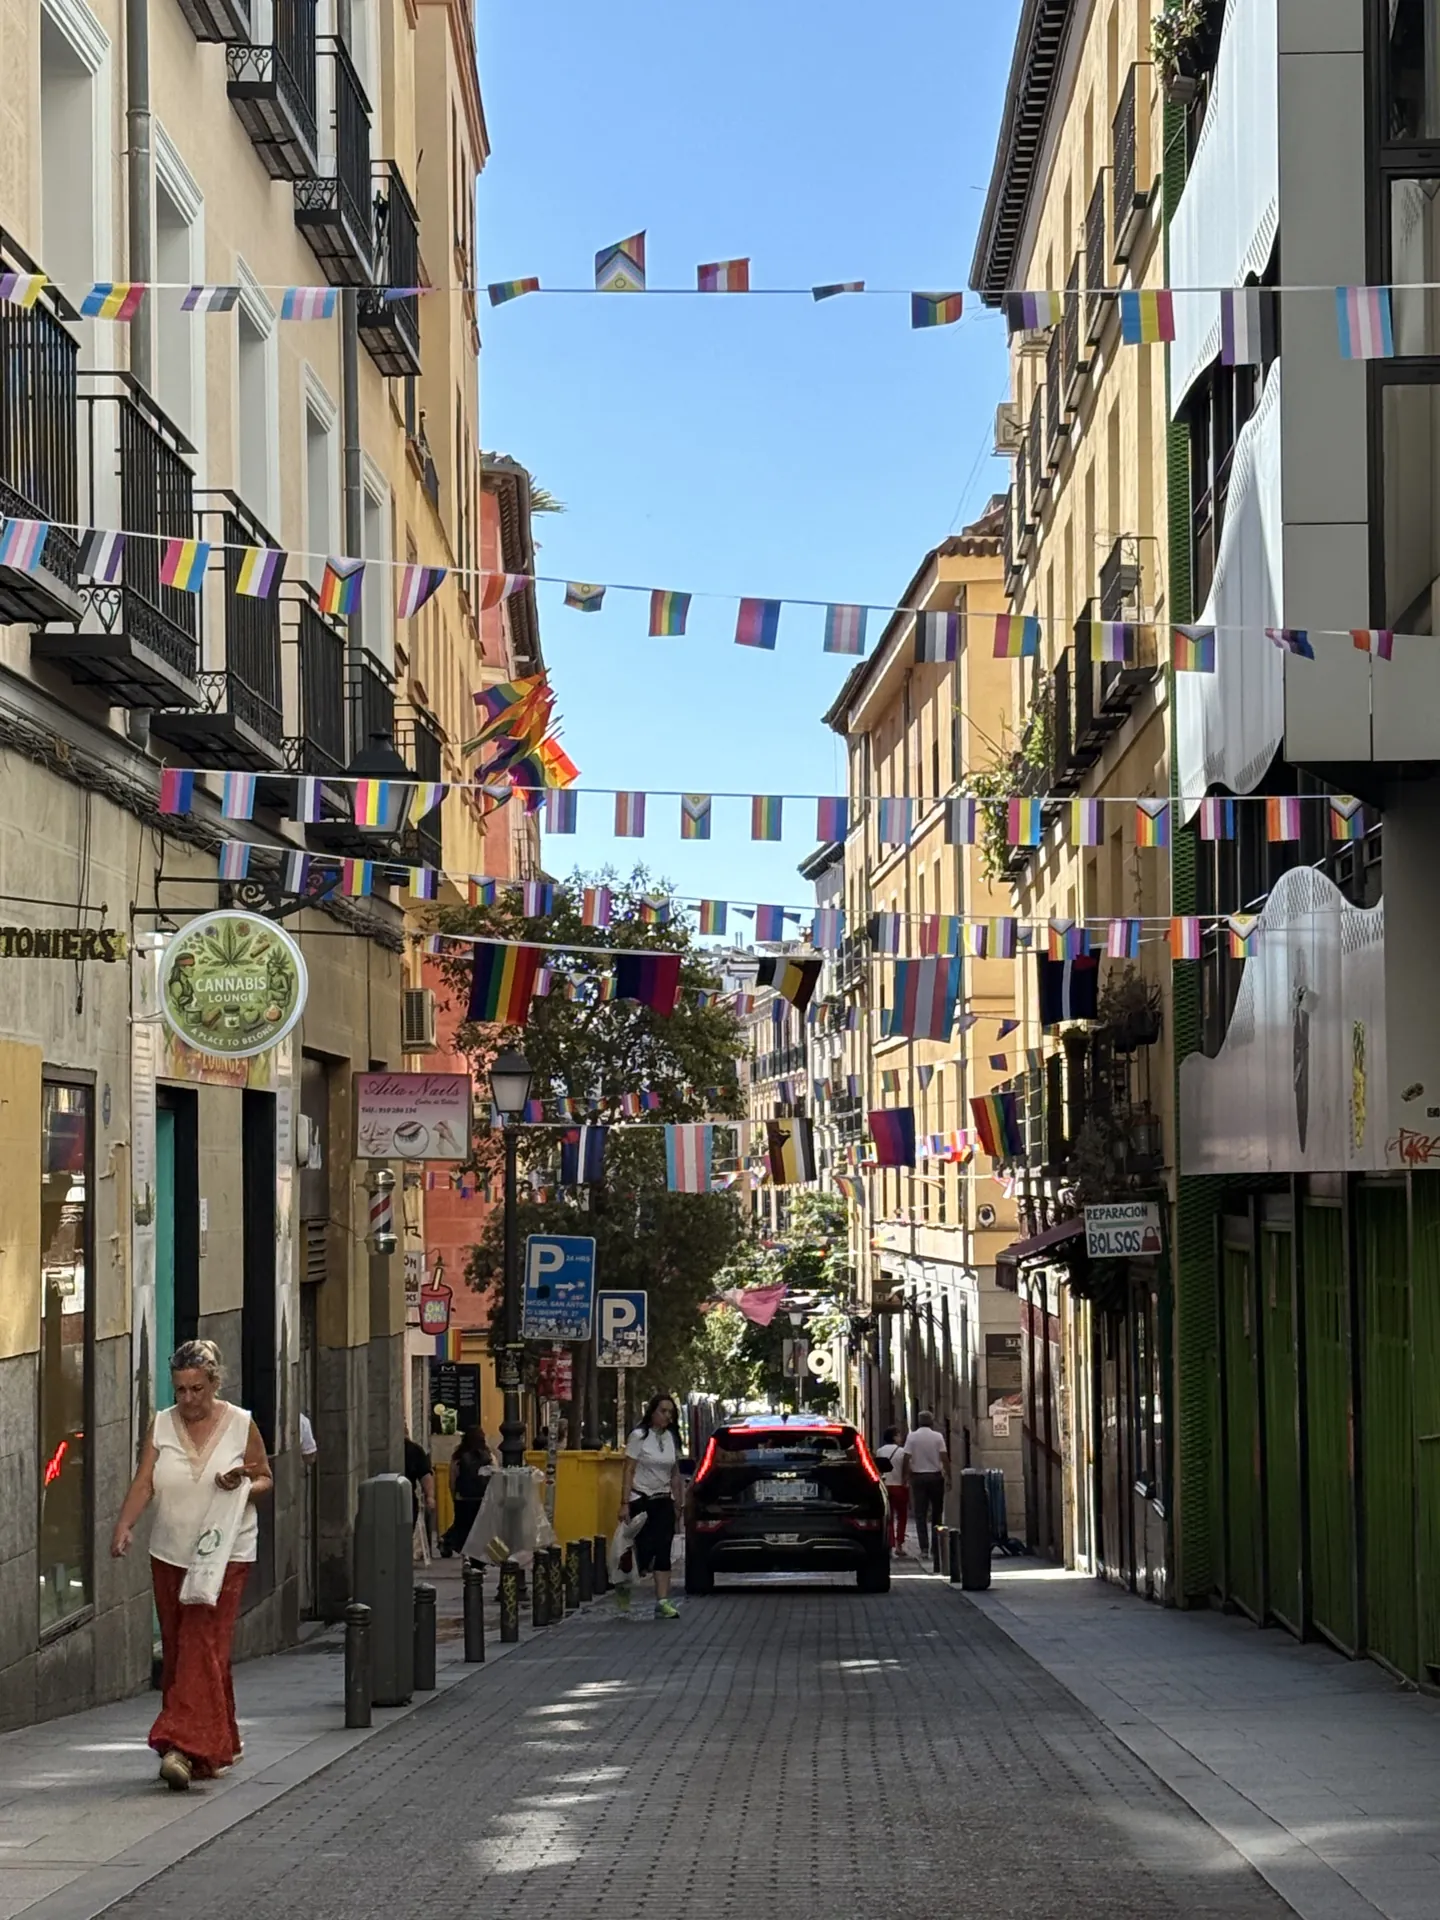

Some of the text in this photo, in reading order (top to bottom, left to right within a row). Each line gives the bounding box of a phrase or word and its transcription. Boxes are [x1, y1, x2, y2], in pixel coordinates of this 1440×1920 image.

[0, 927, 116, 962] TONIERS
[195, 976, 267, 993] CANNABIS
[208, 992, 255, 1003] LOUNGE
[198, 1031, 224, 1047] PLACE
[228, 1038, 240, 1047] TO
[241, 1023, 275, 1046] BELONG
[408, 1077, 461, 1097] Nails
[1089, 1230, 1140, 1255] BOLSOS
[529, 1243, 565, 1288] P
[602, 1298, 636, 1342] P
